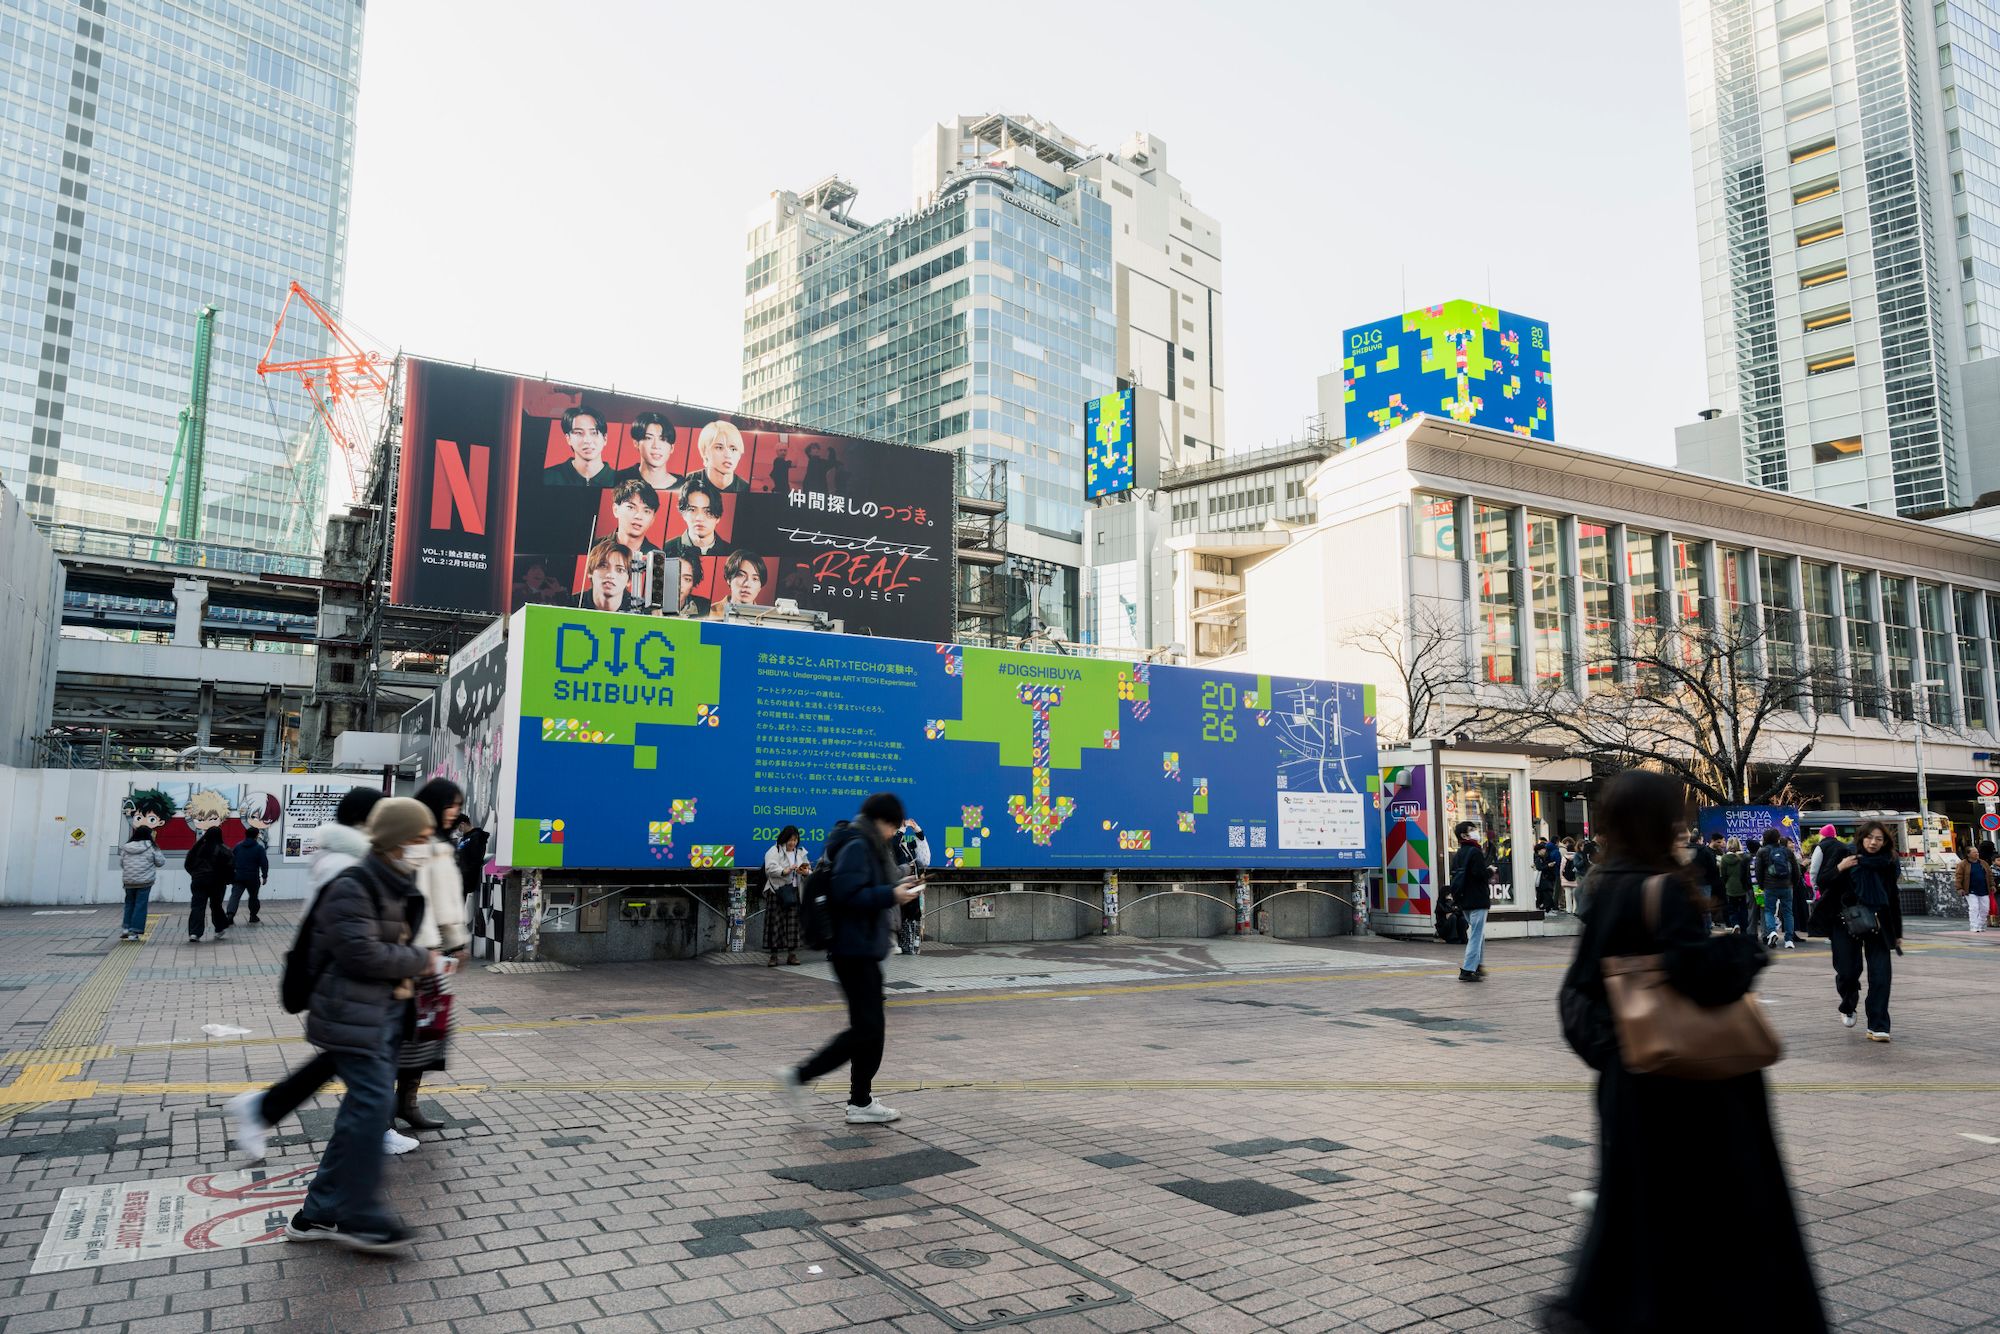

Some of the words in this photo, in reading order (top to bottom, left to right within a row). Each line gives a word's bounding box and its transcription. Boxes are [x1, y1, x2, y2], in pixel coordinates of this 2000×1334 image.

[898, 190, 967, 231] FUKURAS
[1003, 191, 1031, 211] TOKYU
[1033, 208, 1061, 226] PLAZA
[1351, 328, 1383, 349] DIG
[1531, 326, 1543, 339] 20
[1351, 342, 1383, 357] SHIBUYA
[1531, 337, 1544, 350] 26
[430, 439, 490, 536] N
[787, 487, 934, 527] 仲間探しのつづき。
[812, 583, 905, 603] PROJECT
[555, 622, 675, 680] DIG
[757, 668, 792, 678] SHIBUYA:
[793, 671, 832, 682] Undergoing
[880, 677, 919, 688] Experiment.
[998, 662, 1082, 681] #DIGSHIBUYA
[554, 679, 674, 707] SHIBUYA
[1201, 681, 1237, 711] 20
[1202, 711, 1238, 743] 26
[753, 805, 772, 815] DIG
[773, 805, 817, 817] SHIBUYA
[1725, 810, 1772, 820] SHIBUYA
[1726, 819, 1772, 828] WINTER
